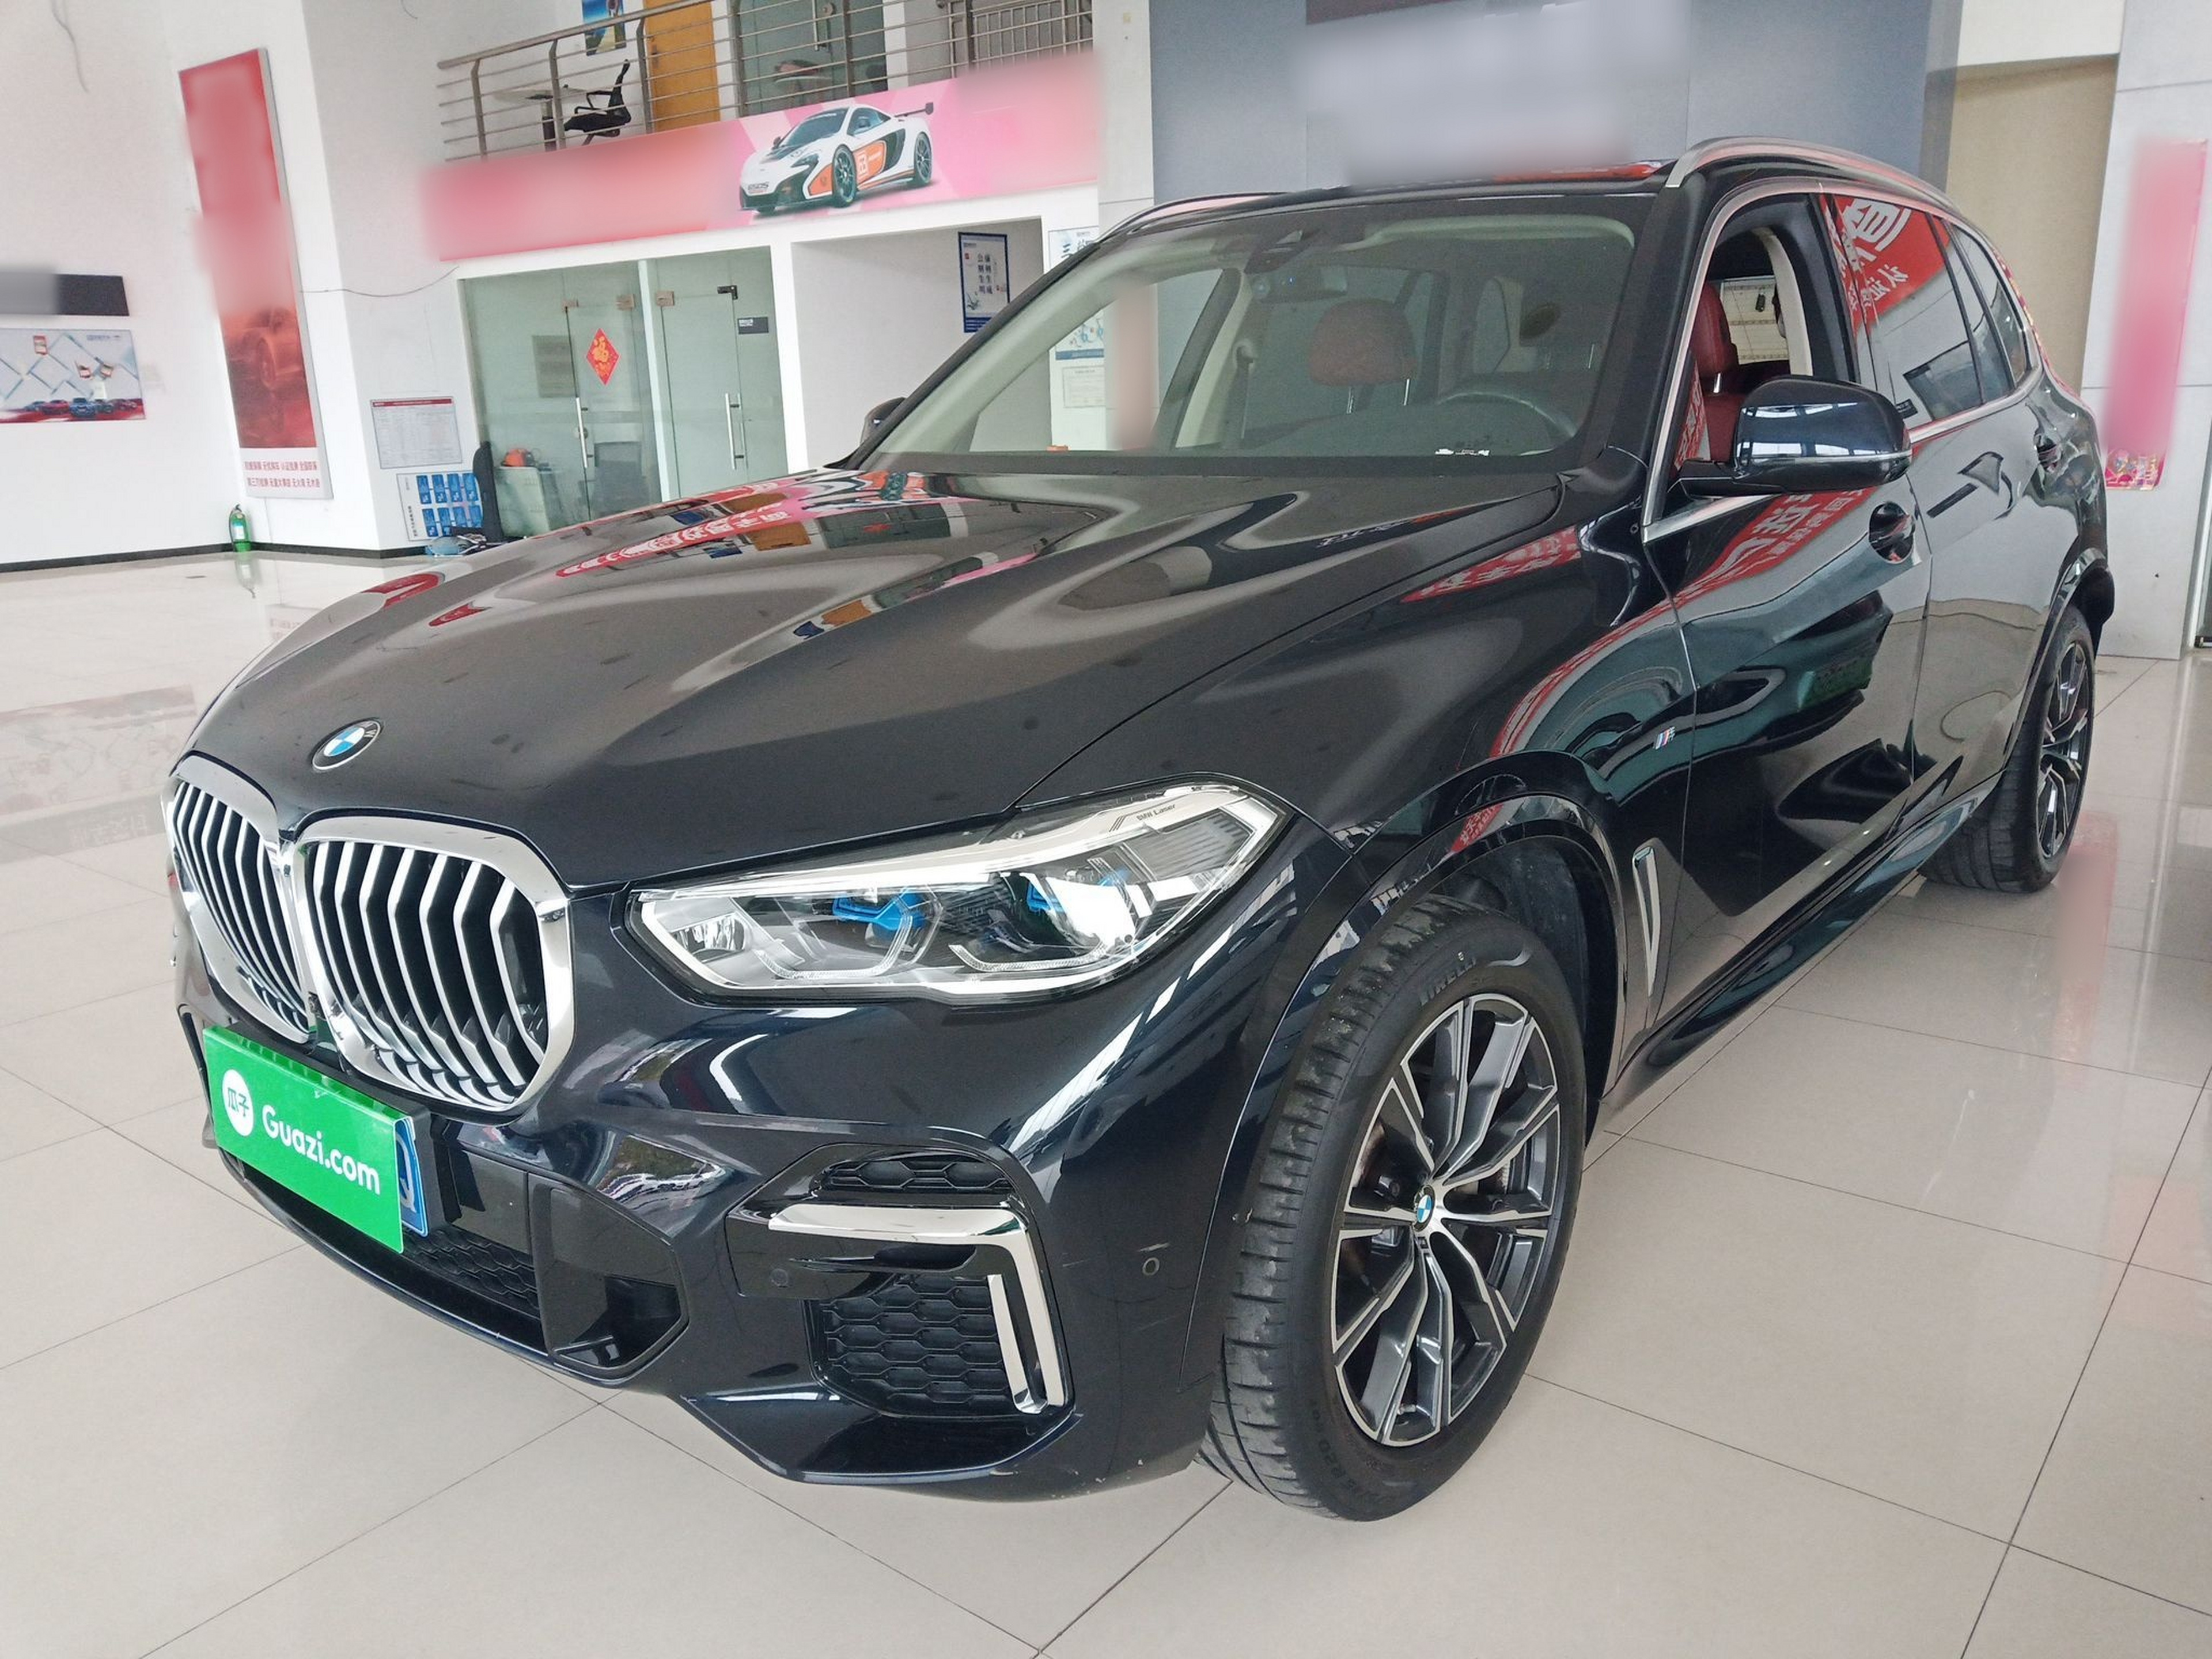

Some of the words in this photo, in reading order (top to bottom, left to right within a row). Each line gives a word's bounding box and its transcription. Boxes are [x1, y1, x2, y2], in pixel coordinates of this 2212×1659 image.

[1137, 812, 1153, 820] BMW
[1154, 804, 1176, 815] Laser
[228, 1087, 249, 1117] 瓜子
[262, 1104, 380, 1195] Guazi.com
